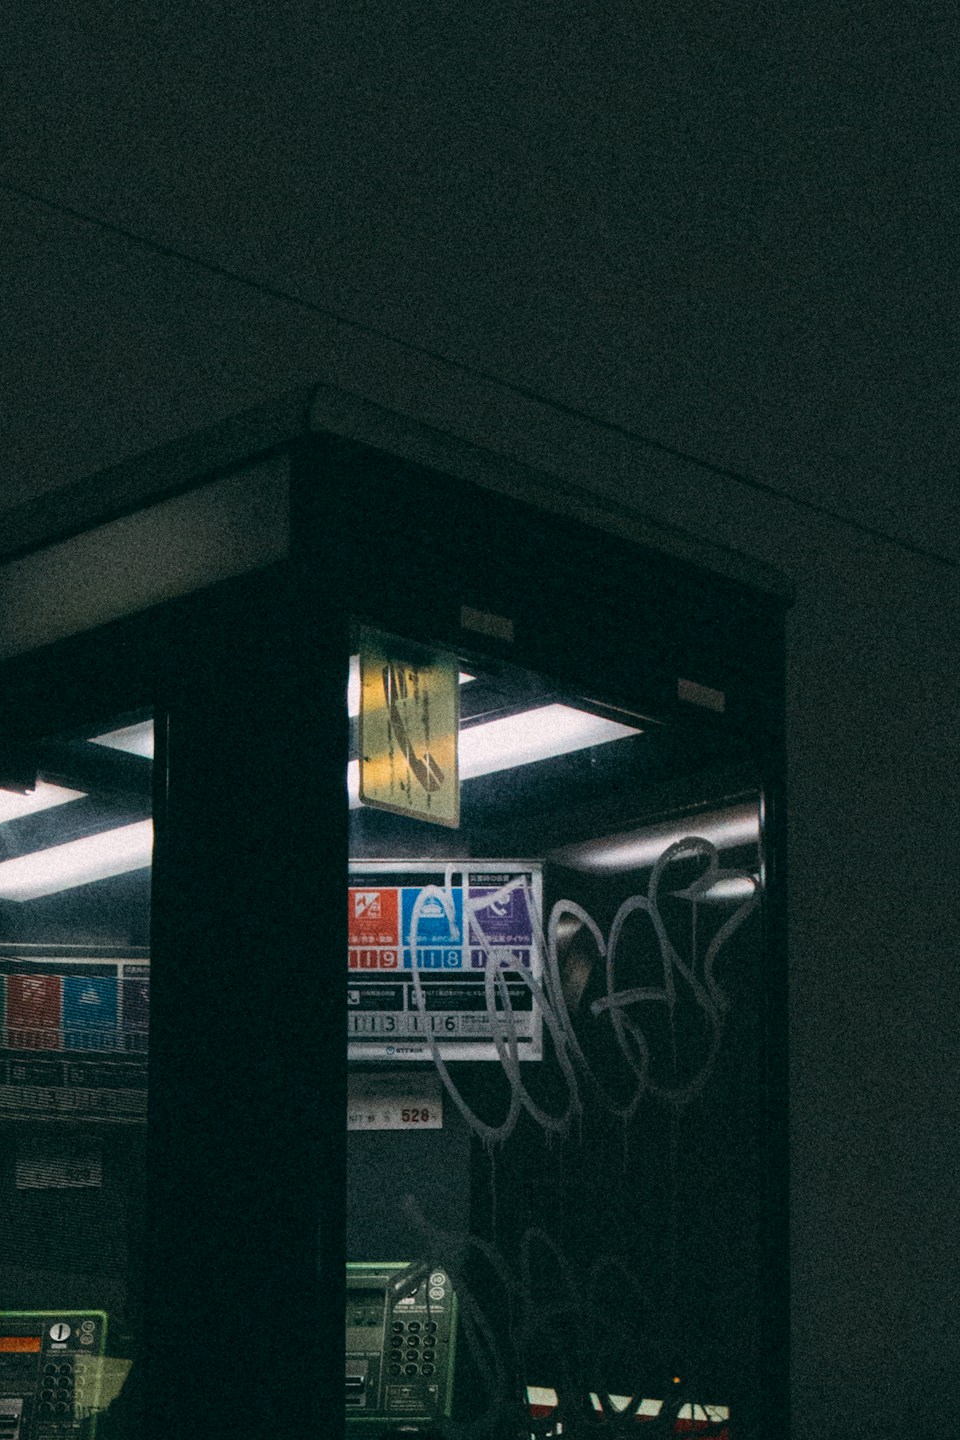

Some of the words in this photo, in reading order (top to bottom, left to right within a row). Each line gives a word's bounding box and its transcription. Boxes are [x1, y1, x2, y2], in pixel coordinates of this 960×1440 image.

[354, 1016, 395, 1031] 113
[414, 1016, 456, 1031] 116
[402, 1108, 430, 1123] 528
